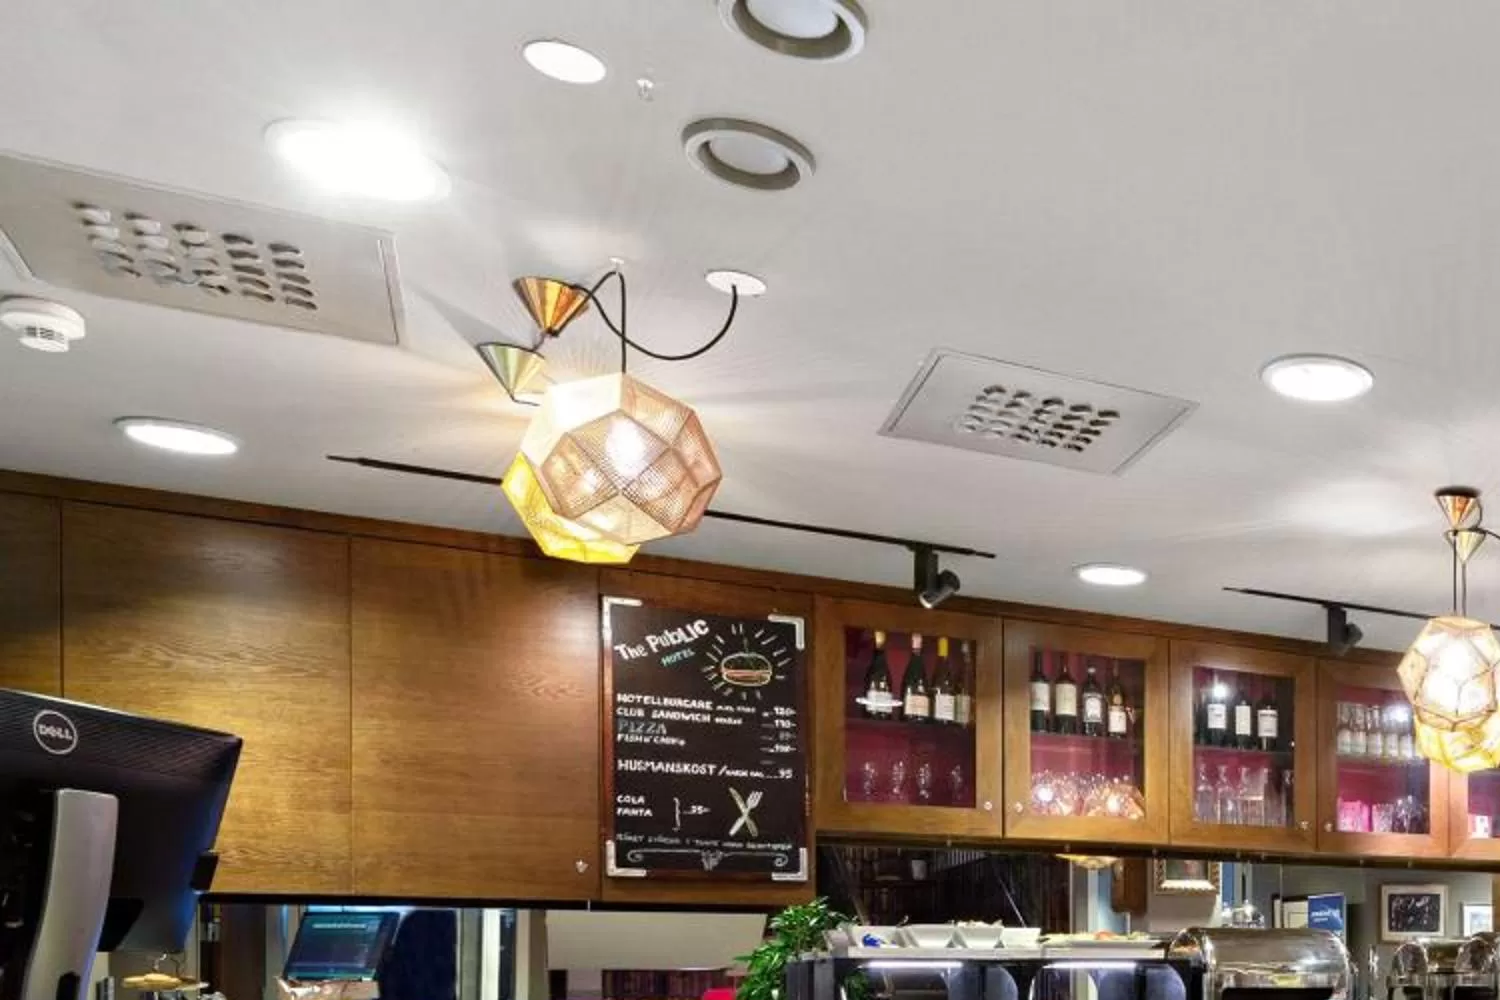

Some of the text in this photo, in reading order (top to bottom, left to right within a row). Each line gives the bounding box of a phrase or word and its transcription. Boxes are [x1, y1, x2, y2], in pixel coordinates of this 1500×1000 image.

[613, 643, 648, 660] The
[616, 706, 645, 717] CLUB
[651, 709, 711, 723] SANDWICH
[38, 724, 73, 740] DELL
[618, 719, 667, 735] PIZZA
[617, 759, 717, 776] HUSMANSKOST
[617, 795, 645, 805] COLA
[617, 807, 653, 817] FANTA
